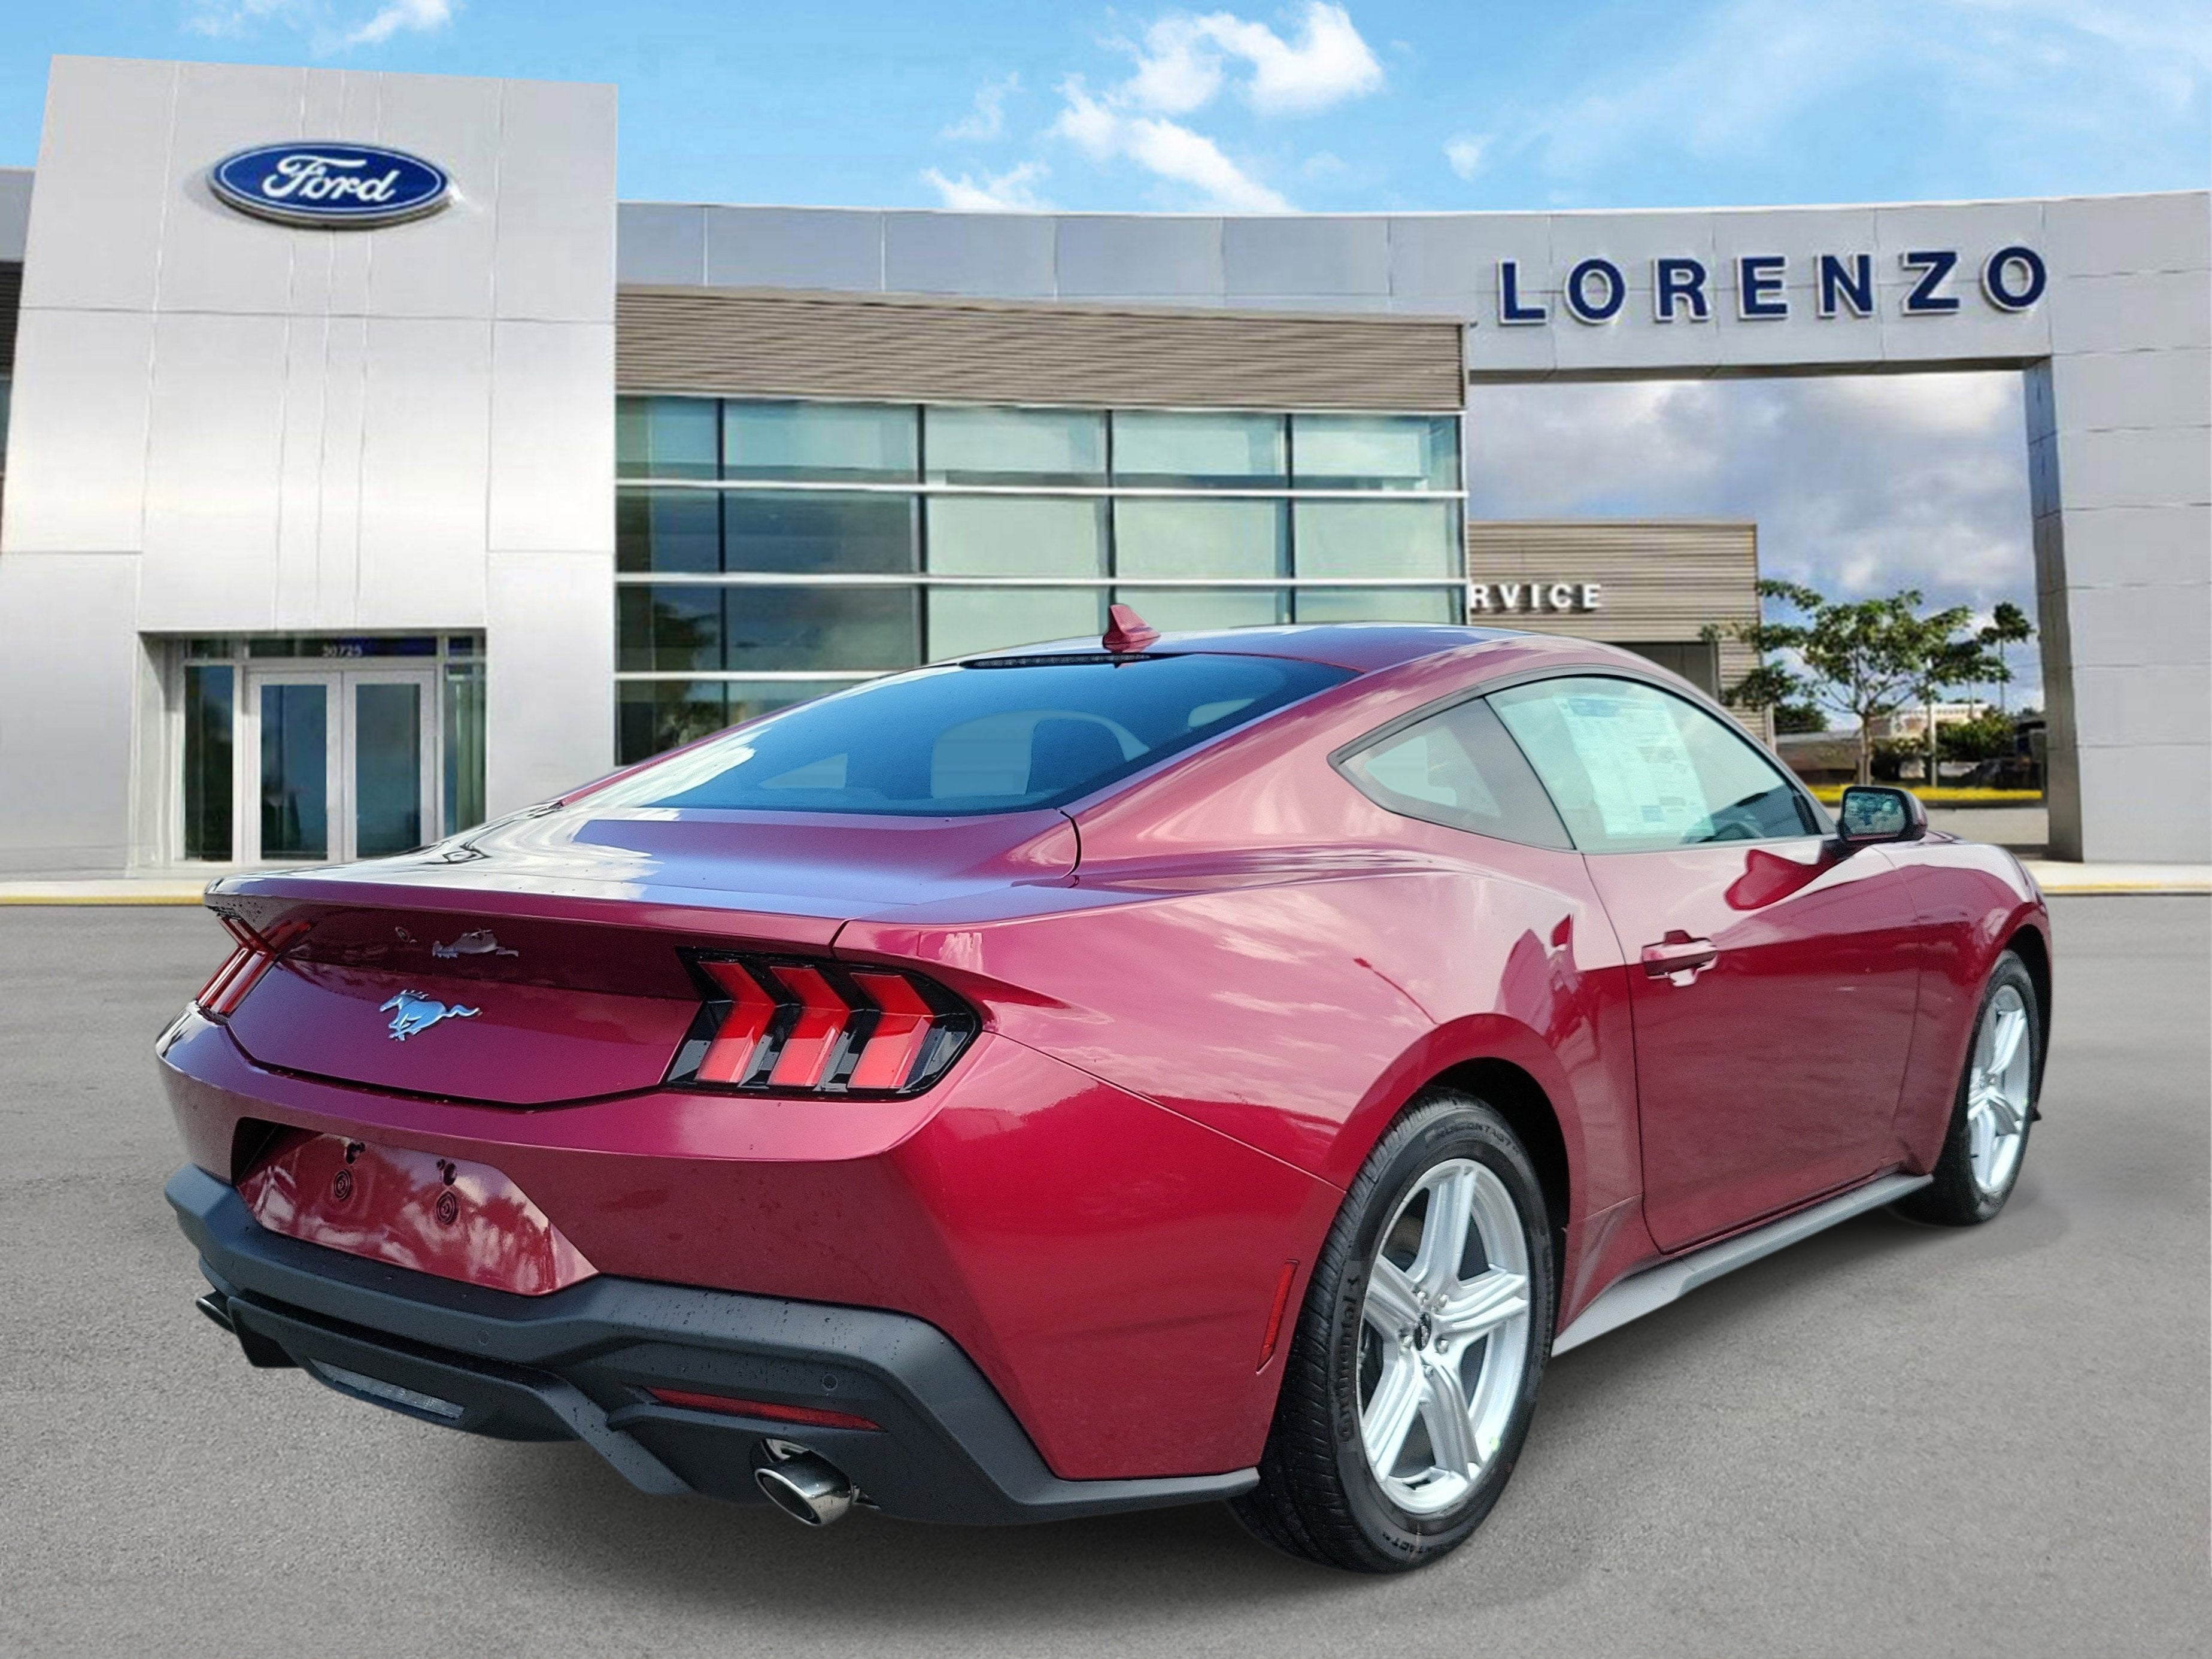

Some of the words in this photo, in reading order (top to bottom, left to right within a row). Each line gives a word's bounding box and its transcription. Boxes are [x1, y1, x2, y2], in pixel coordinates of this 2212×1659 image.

[262, 154, 400, 201] Ford
[1499, 245, 2047, 324] LORENZO
[1470, 583, 1602, 609] RVICE
